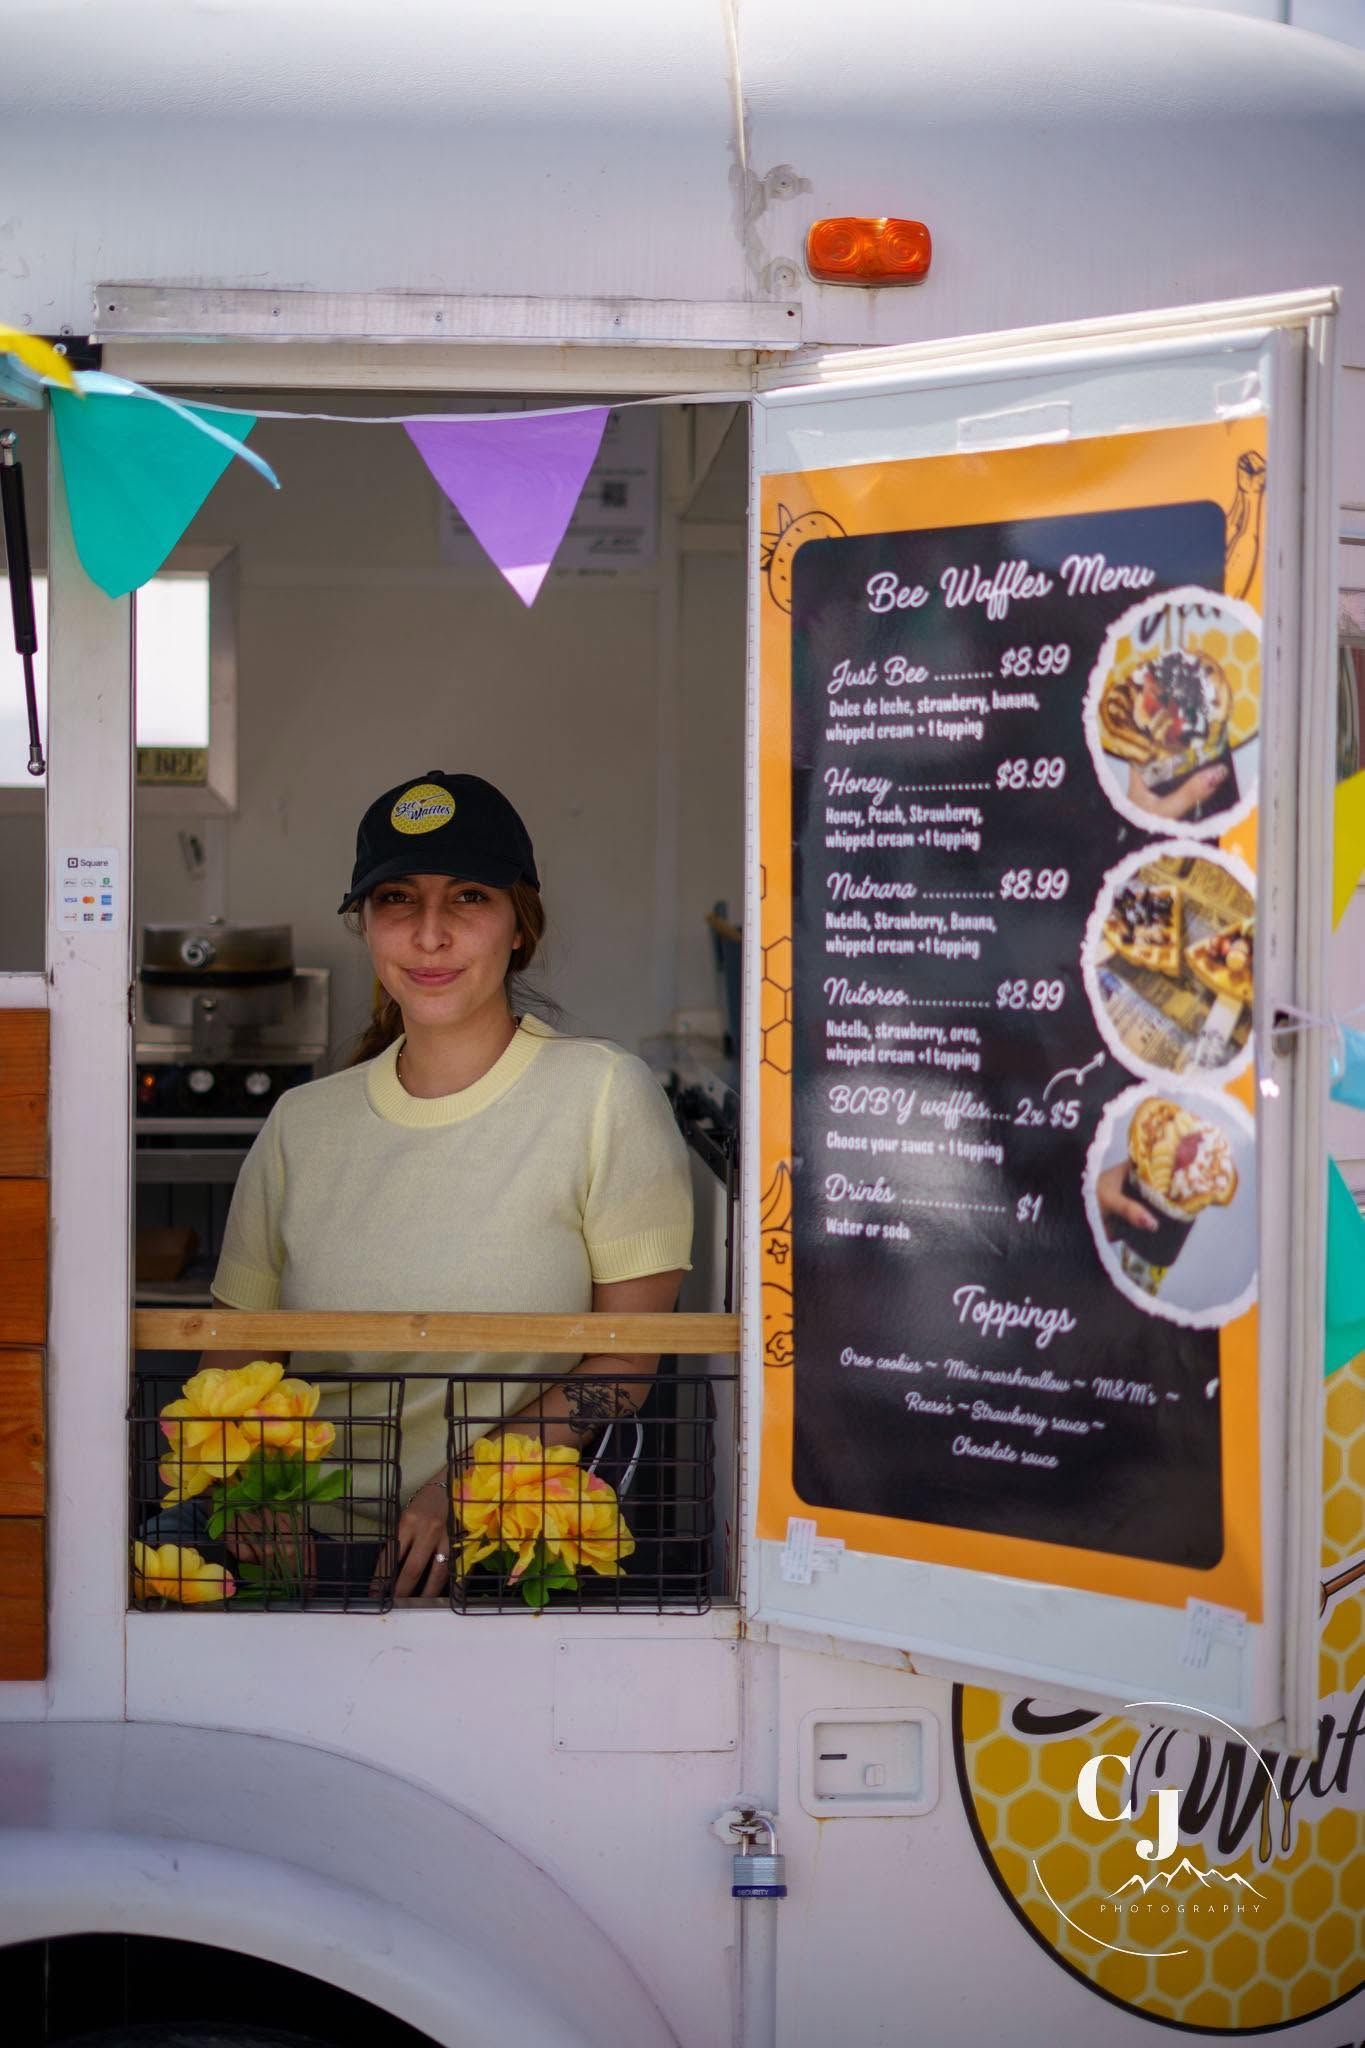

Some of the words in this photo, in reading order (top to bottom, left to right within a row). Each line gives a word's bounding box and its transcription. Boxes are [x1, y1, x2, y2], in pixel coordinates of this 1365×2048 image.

[866, 571, 929, 613] Bee
[940, 560, 1053, 621] Waffles
[1060, 553, 1155, 597] Menu
[827, 659, 877, 695] Just
[884, 655, 929, 687] Bee
[1000, 643, 1071, 678] $8.99
[829, 700, 861, 717] Dulce
[863, 699, 878, 715] de
[879, 697, 915, 717] leche,
[917, 692, 990, 715] strawberry,
[992, 690, 1040, 711] banana,
[826, 724, 875, 744] whipped
[876, 723, 914, 739] cream
[936, 717, 984, 740] topping
[824, 767, 892, 806] Honey
[996, 757, 1066, 790] $8.99
[825, 807, 865, 828] Honey,
[868, 804, 908, 826] Peach,
[909, 804, 984, 826] Strawberry,
[825, 829, 875, 852] whipped
[876, 831, 915, 848] cream
[933, 827, 981, 851] topping
[80, 859, 109, 868] Square
[827, 872, 918, 900] Nutnana
[1000, 868, 1069, 901] $8.99
[825, 912, 871, 931] Nutella,
[874, 911, 948, 934] Strawberry,
[950, 912, 998, 933] Banana,
[825, 935, 875, 959] whipped
[876, 938, 915, 954] cream
[933, 936, 981, 960] topping
[995, 978, 1065, 1011] $8.99
[826, 1019, 872, 1040] Nutella,
[874, 1021, 948, 1045] strawberry,
[949, 1026, 981, 1046] oreo,
[826, 1042, 876, 1066] whipped
[877, 1047, 915, 1065] cream
[933, 1047, 980, 1072] topping
[828, 1085, 916, 1125] BABY
[1013, 1097, 1047, 1126] 2x
[1050, 1099, 1081, 1129] $5
[826, 1131, 868, 1150] Choose
[870, 1136, 899, 1155] your
[901, 1140, 935, 1155] sauce
[957, 1140, 1004, 1165] topping
[825, 1173, 896, 1203] Drinks
[1015, 1193, 1043, 1223] $1
[826, 1217, 863, 1237] Water
[865, 1223, 880, 1238] or
[882, 1222, 911, 1240] soda
[952, 1284, 1077, 1349] Toppings
[840, 1347, 873, 1368] Oreo
[876, 1354, 923, 1374] cookies
[944, 1358, 981, 1380] Mini
[982, 1365, 1071, 1393] marshmallow
[1092, 1377, 1157, 1406] M&M's
[905, 1391, 955, 1416] Reese's
[971, 1400, 1048, 1437] Strawberry
[1051, 1415, 1089, 1435] sauce
[952, 1435, 1017, 1463] Chocolate
[1021, 1449, 1059, 1469] sauce
